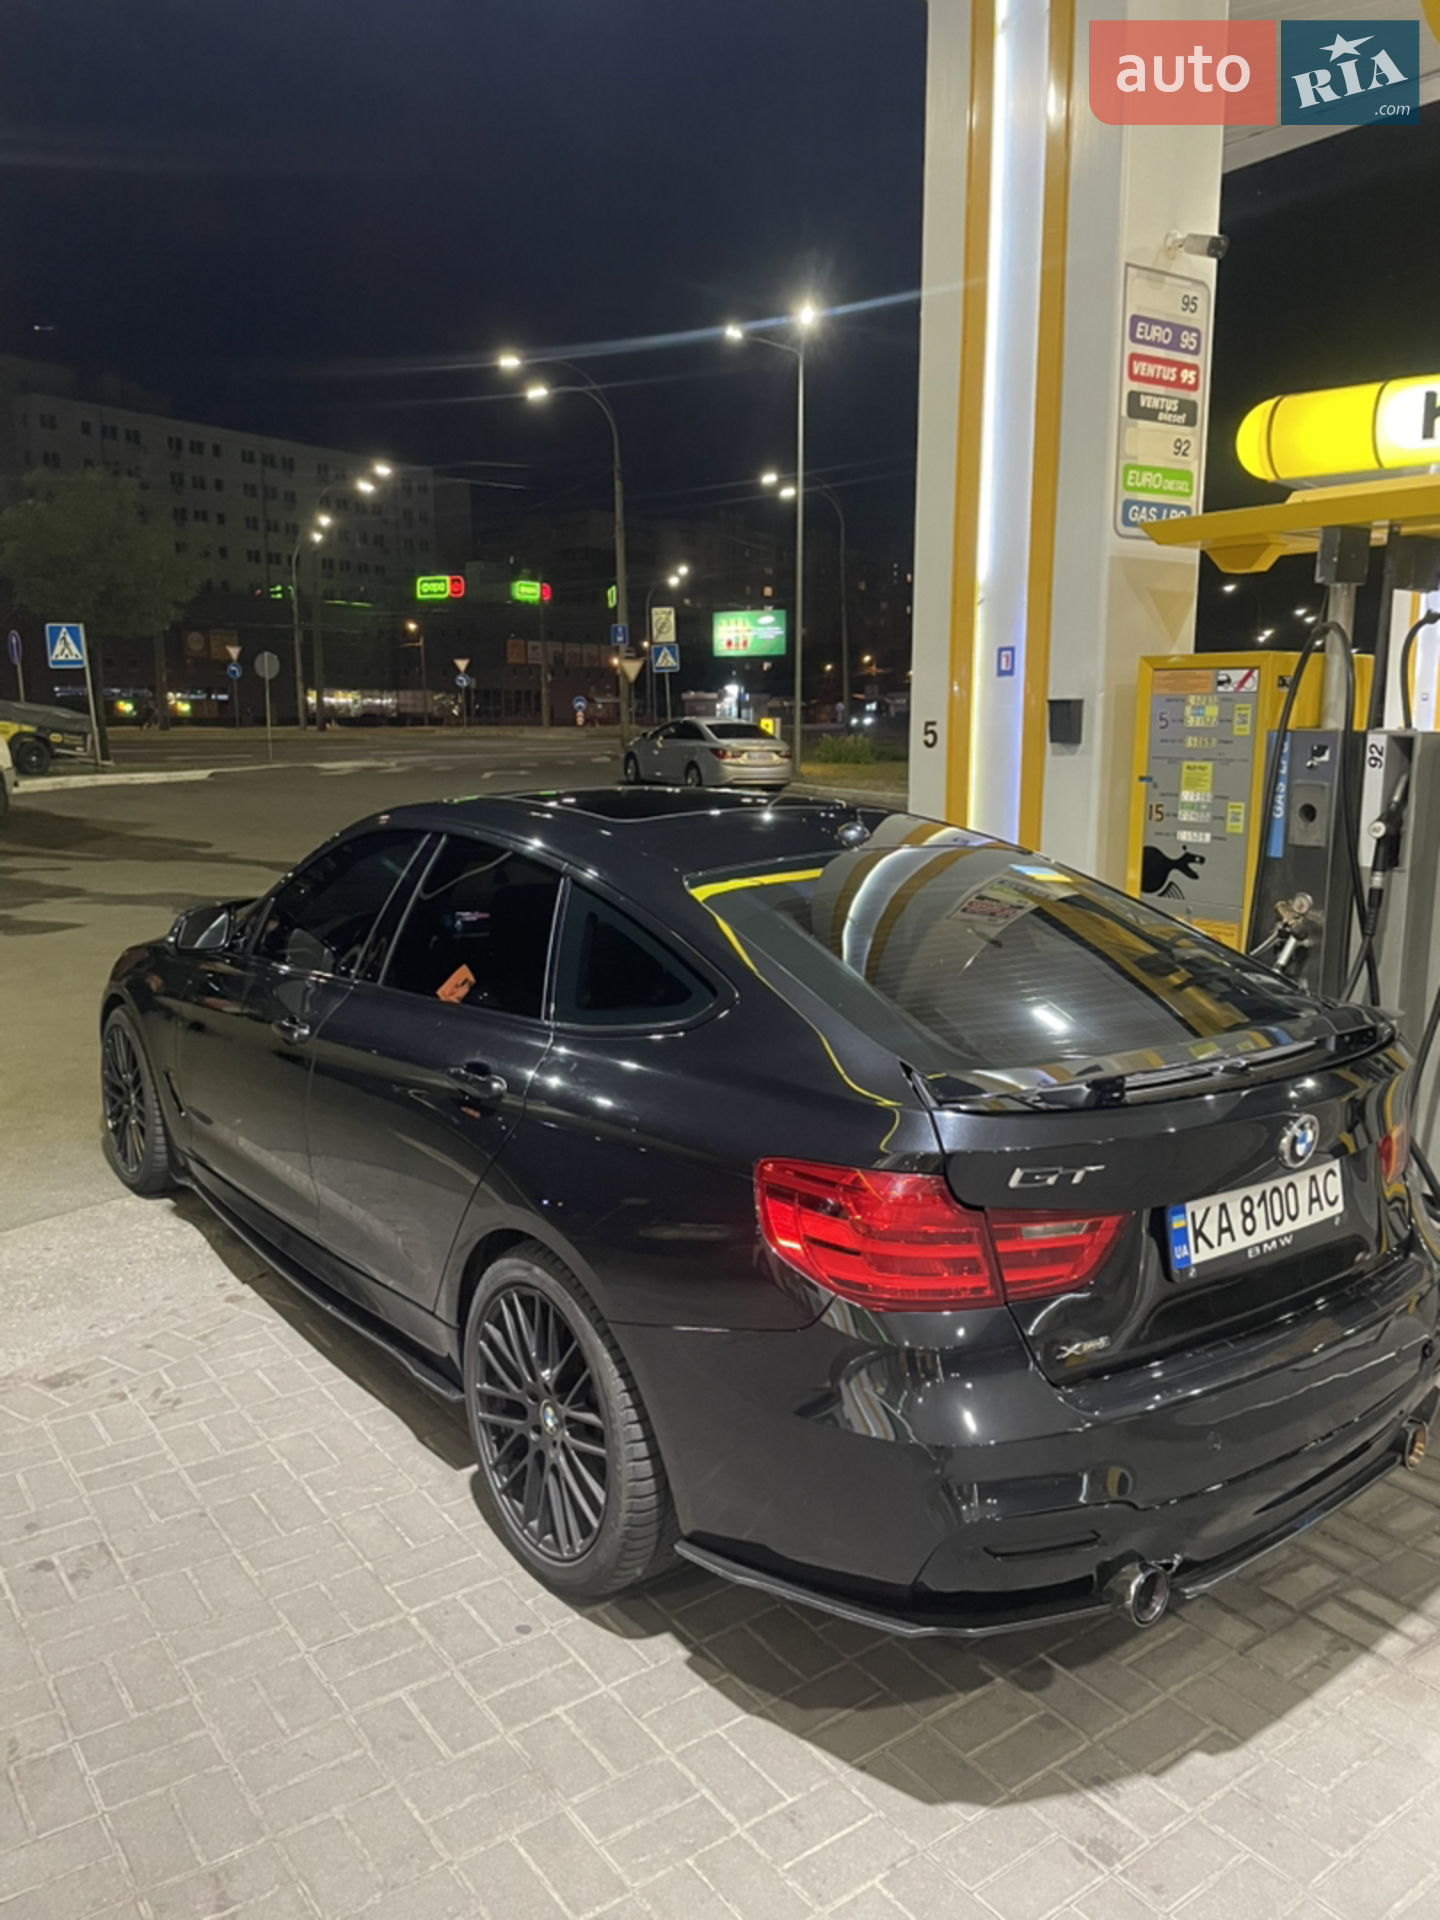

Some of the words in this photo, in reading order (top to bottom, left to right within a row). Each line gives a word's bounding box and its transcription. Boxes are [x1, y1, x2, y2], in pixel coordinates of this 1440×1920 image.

[1181, 294, 1198, 314] 95
[1135, 322, 1172, 344] EURO
[1180, 330, 1198, 351] 95
[1132, 360, 1177, 381] VENTUS
[1180, 368, 1197, 385] 95
[1139, 394, 1179, 412] VENTUS
[1173, 438, 1191, 457] 92
[1126, 470, 1162, 489] EURO
[1162, 478, 1190, 493] DIESEL
[1128, 505, 1157, 522] GAS
[1158, 711, 1169, 730] 5
[923, 721, 938, 748] 5
[1368, 743, 1384, 769] 92
[1272, 781, 1286, 818] GAS
[1148, 803, 1165, 822] 15
[1008, 1164, 1105, 1188] GT
[1190, 1202, 1236, 1254] KA
[1240, 1181, 1300, 1237] 8100
[1307, 1168, 1339, 1215] AC
[1174, 1245, 1190, 1259] UA
[1247, 1234, 1294, 1259] BMW
